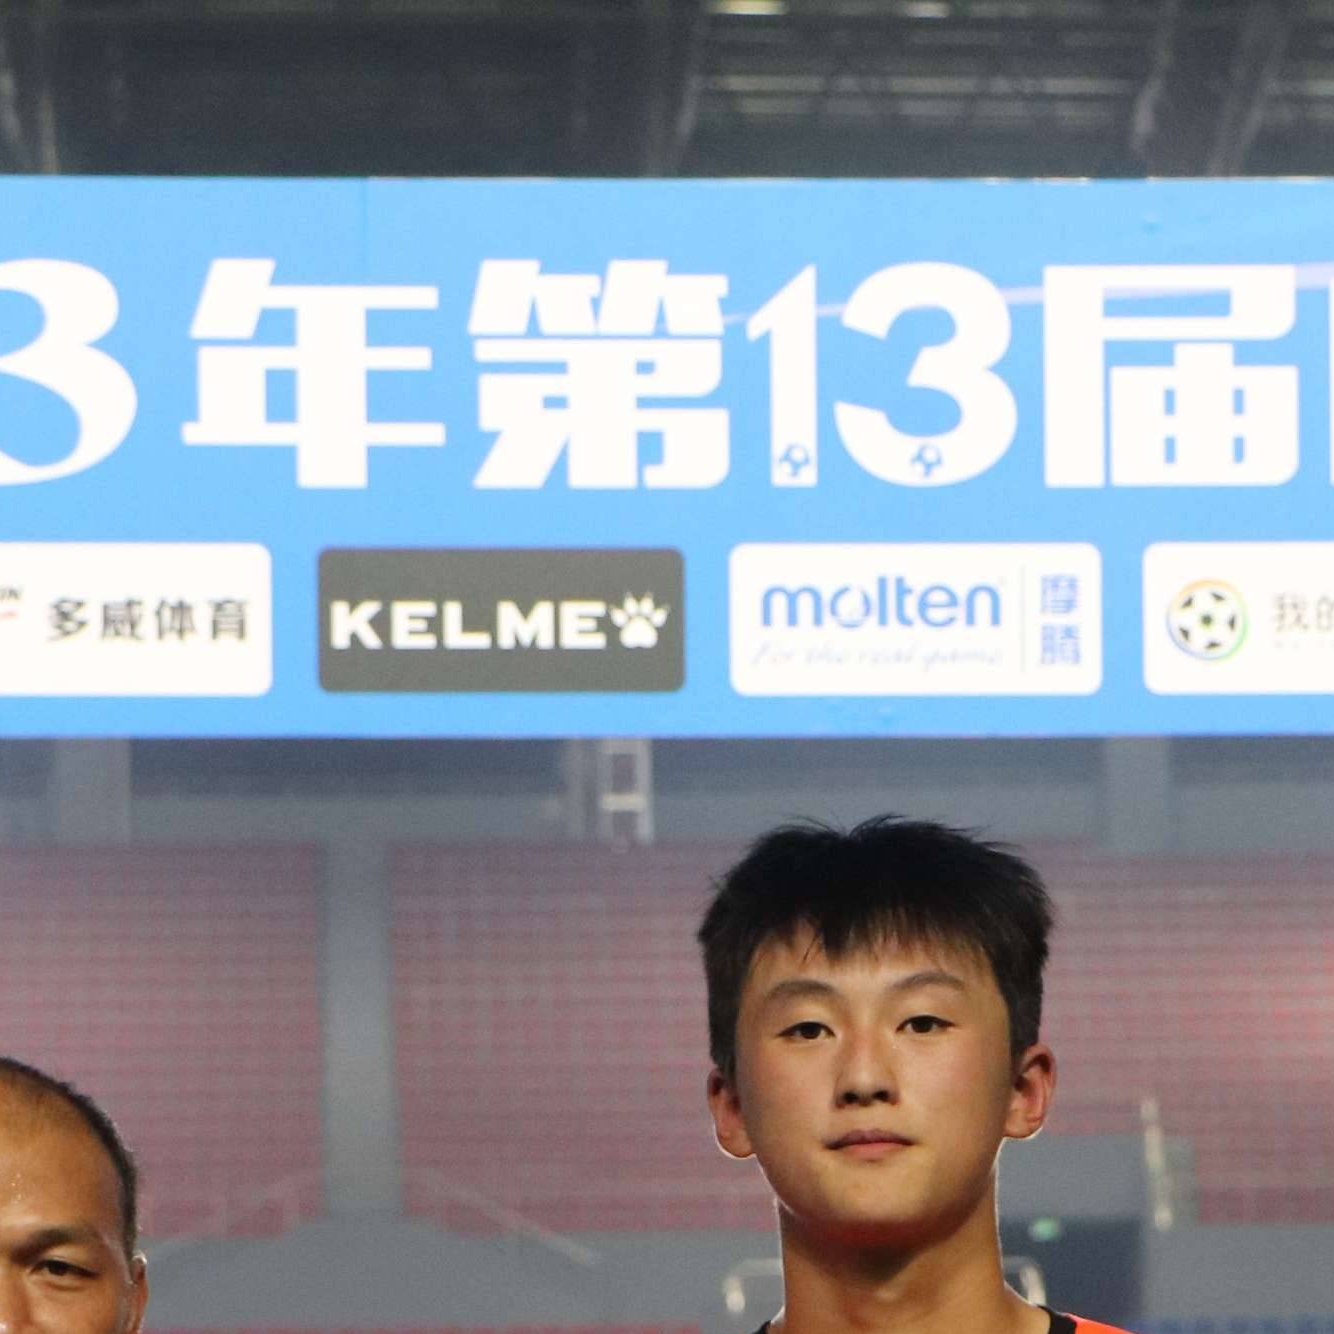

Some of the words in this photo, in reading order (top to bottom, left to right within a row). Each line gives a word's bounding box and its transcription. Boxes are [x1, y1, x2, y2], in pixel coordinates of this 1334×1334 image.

[46, 596, 251, 641] 多威体育
[330, 600, 607, 651] KELME
[760, 576, 1002, 630] molten
